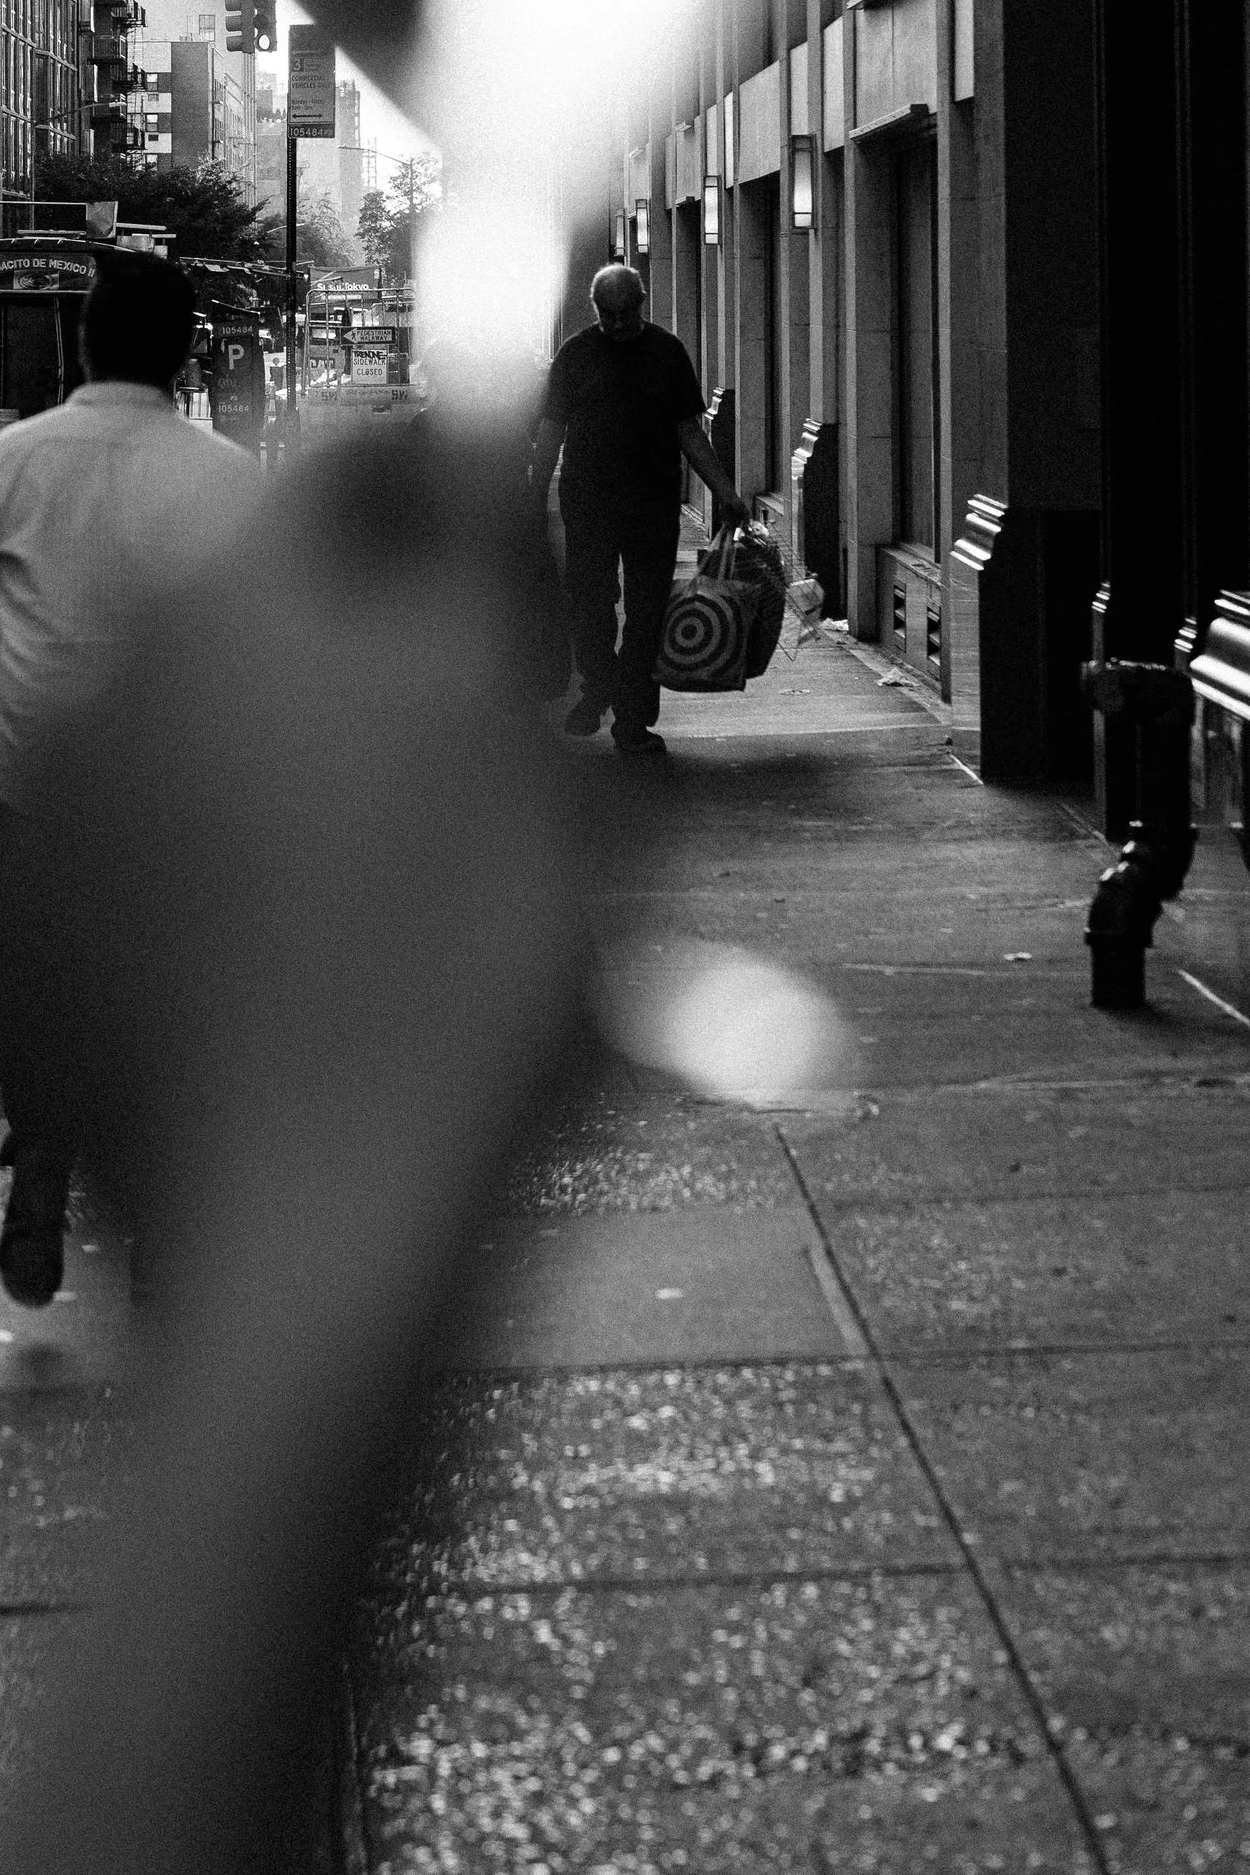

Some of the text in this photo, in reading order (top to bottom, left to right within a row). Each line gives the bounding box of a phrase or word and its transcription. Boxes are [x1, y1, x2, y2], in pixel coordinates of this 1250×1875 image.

[290, 127, 323, 137] 105484
[32, 258, 47, 268] DE
[48, 259, 87, 275] MEXICO
[222, 325, 253, 334] 105484
[228, 344, 245, 370] P
[356, 368, 383, 376] CLOSED
[218, 405, 249, 413] 105484
